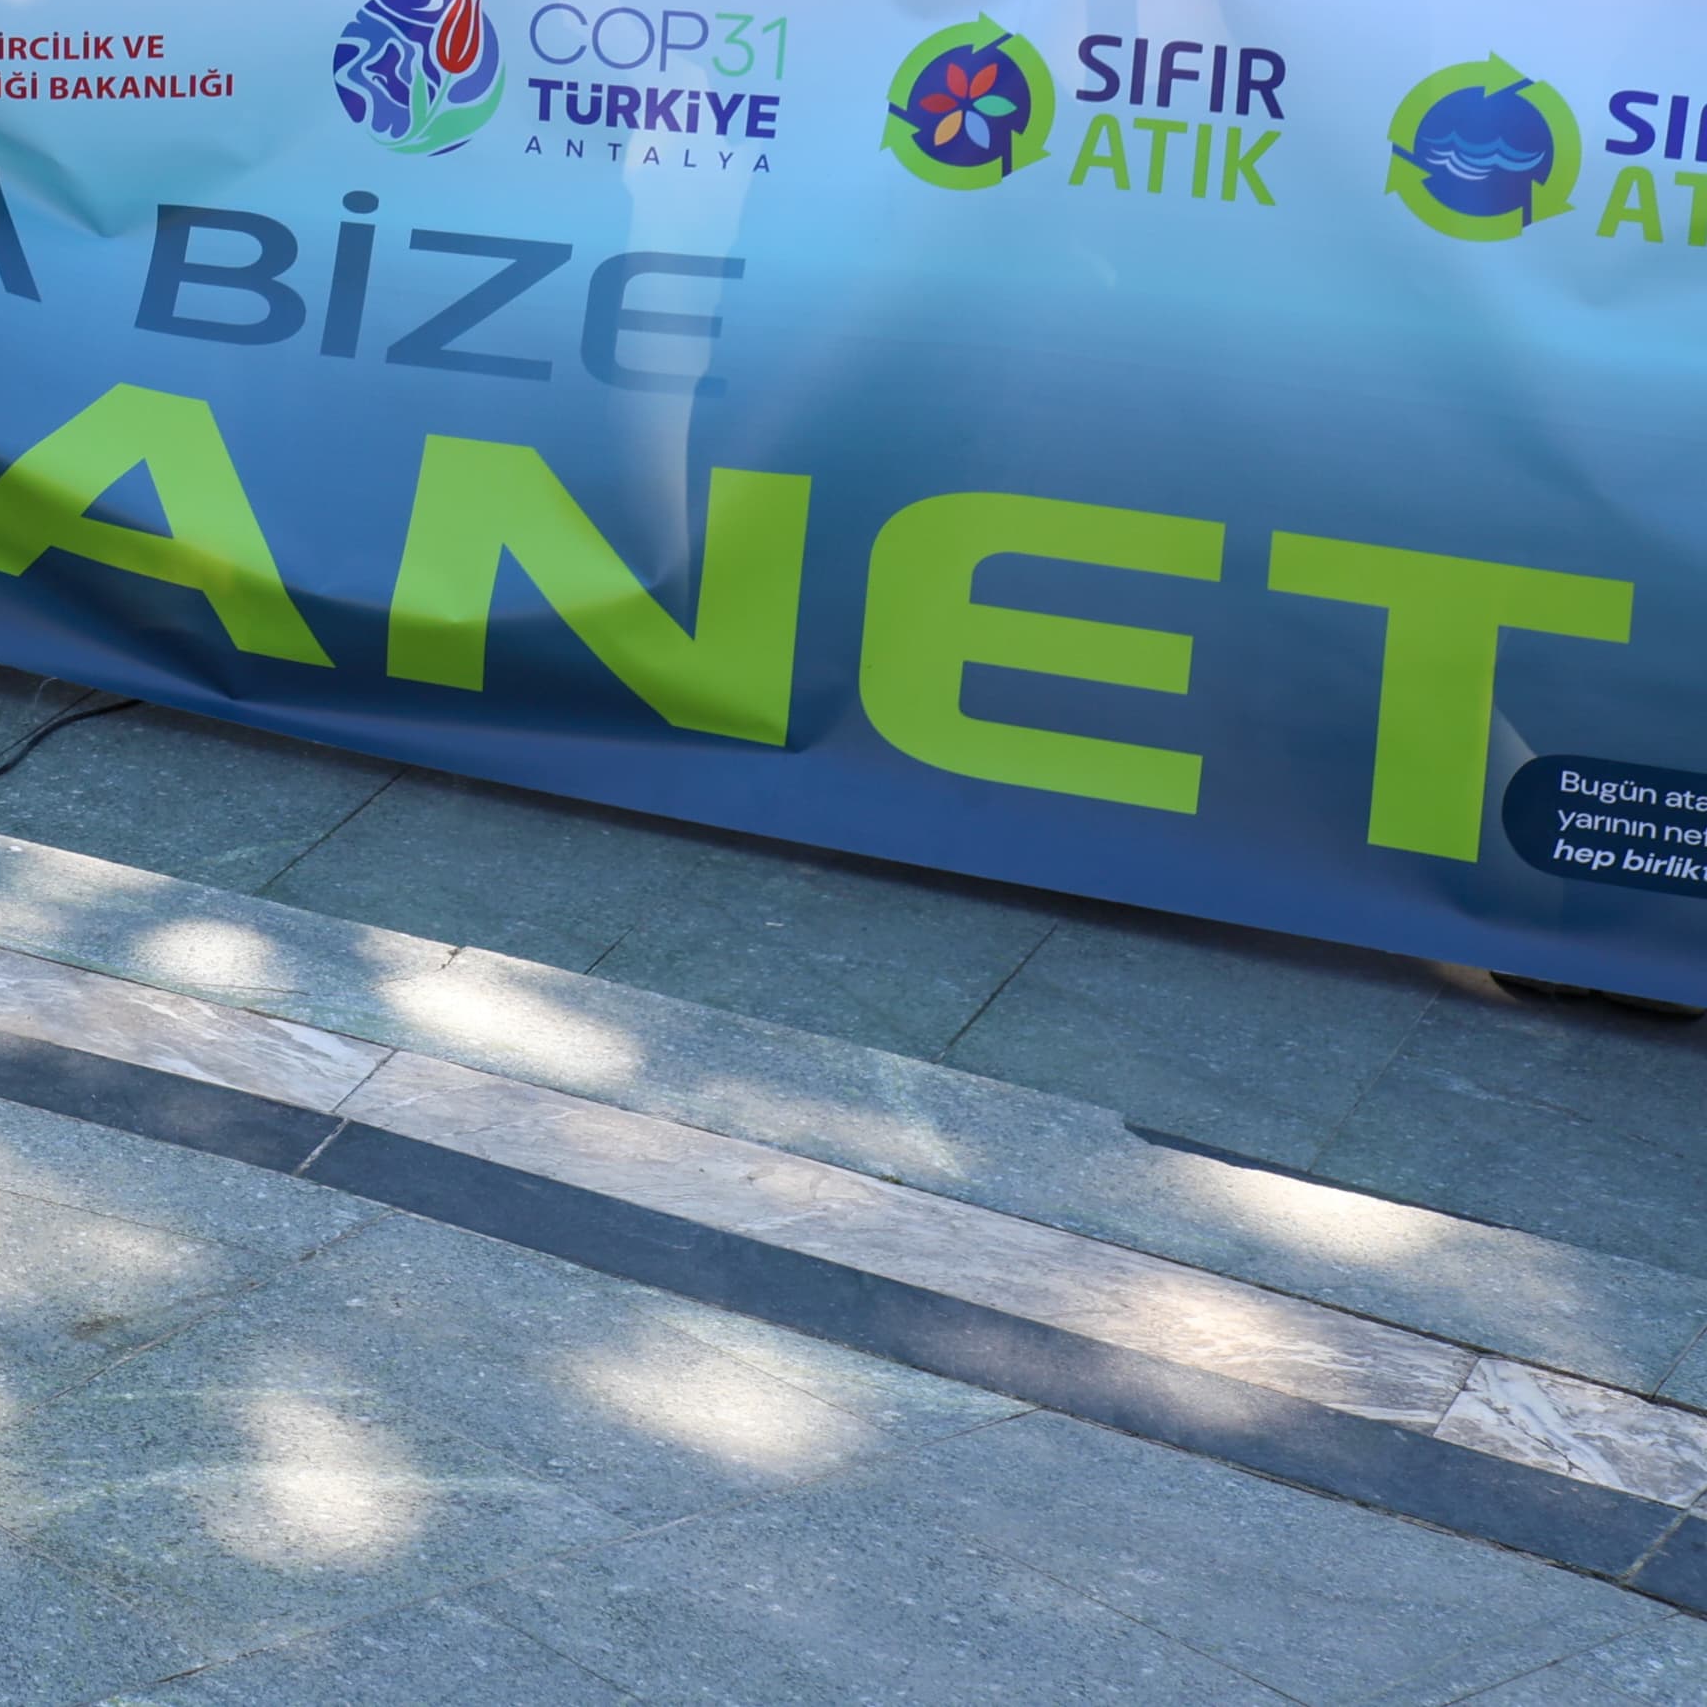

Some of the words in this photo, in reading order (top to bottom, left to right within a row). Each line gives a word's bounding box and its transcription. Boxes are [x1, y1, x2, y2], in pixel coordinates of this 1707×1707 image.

[123, 34, 165, 60] VE
[529, 2, 788, 81] COP31
[50, 67, 236, 100] BAKANLIĞI
[1073, 33, 1288, 120] SIFIR
[527, 77, 781, 139] TÜRKİYE
[1605, 90, 1707, 163] SI
[525, 134, 772, 174] ANTALYA
[1067, 112, 1284, 207] ATIK
[133, 190, 747, 399] BİZE
[1559, 769, 1658, 805] Bugün
[1557, 809, 1657, 840] yarının
[1552, 838, 1616, 871] hep
